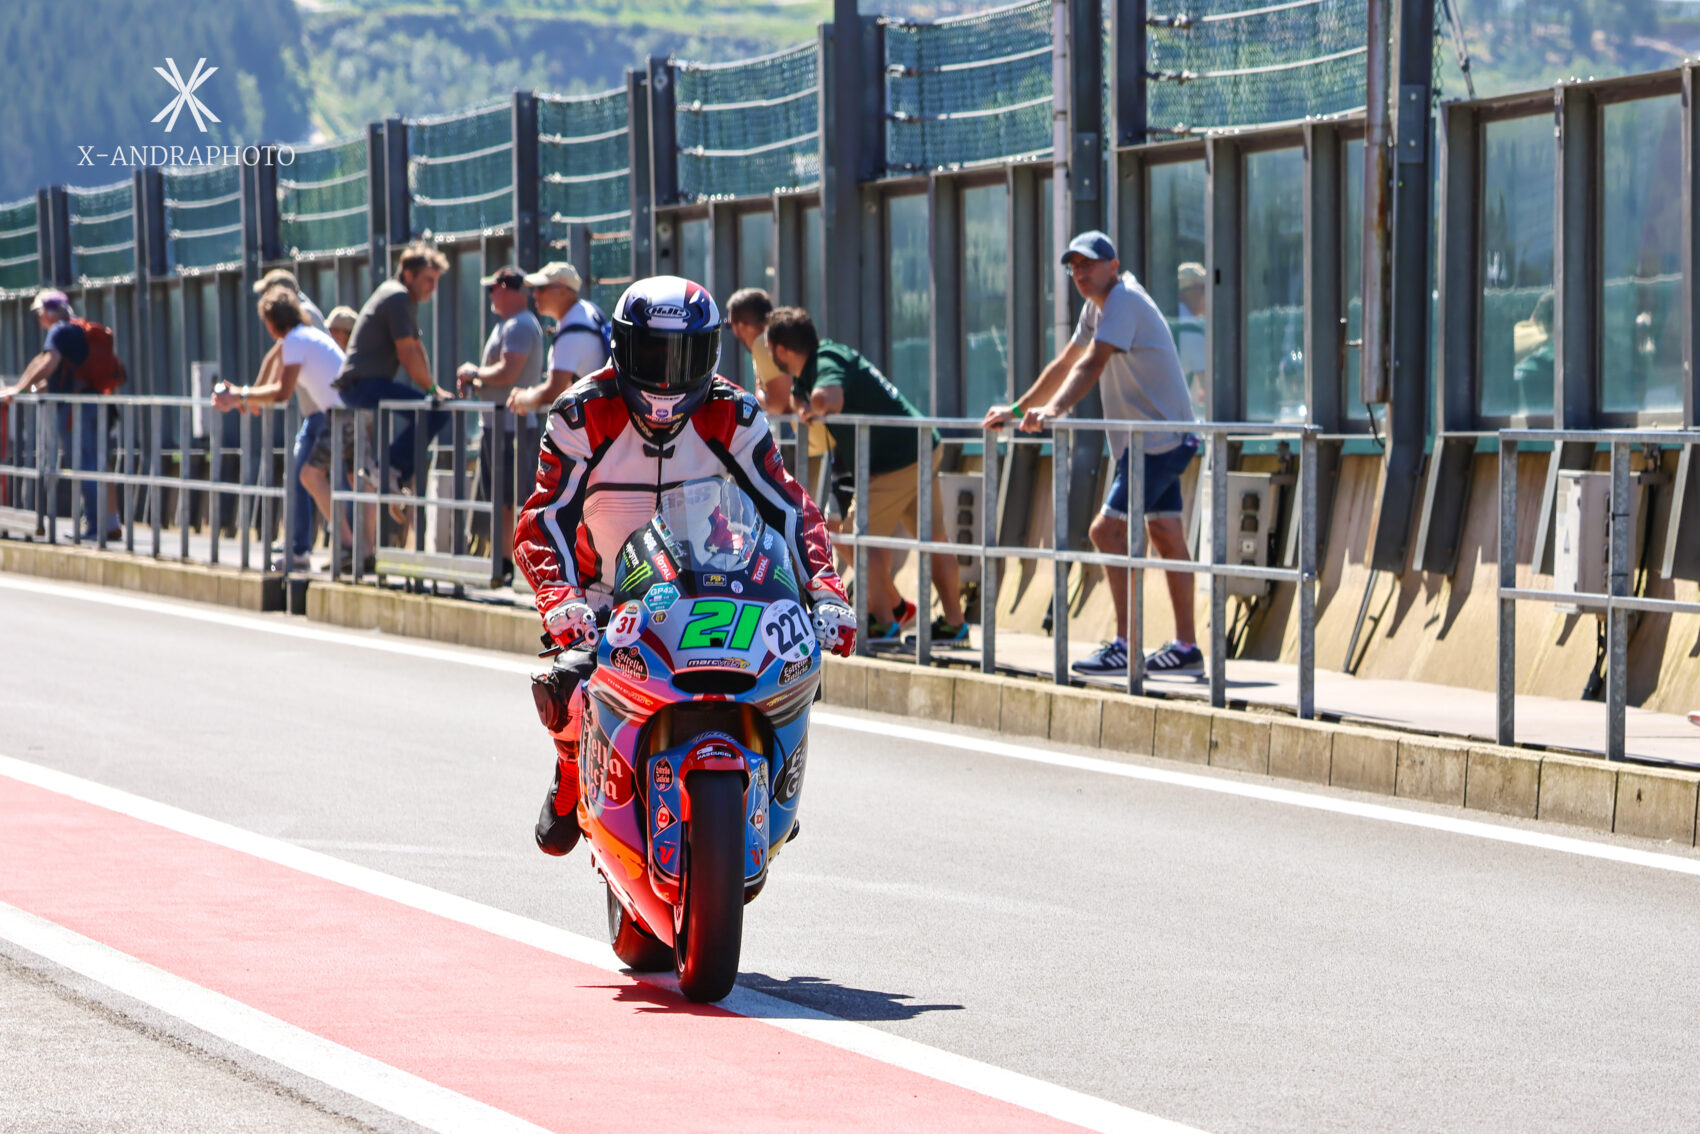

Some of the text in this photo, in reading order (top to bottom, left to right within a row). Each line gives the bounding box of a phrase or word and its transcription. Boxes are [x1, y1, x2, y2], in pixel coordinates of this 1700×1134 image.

[655, 554, 672, 580] TOTAL
[752, 558, 769, 581] TOTAL
[650, 586, 674, 596] GP42
[615, 616, 637, 635] 31
[678, 600, 765, 651] 21
[765, 604, 810, 655] 227
[614, 657, 641, 680] Galicia
[616, 648, 644, 673] Estrella
